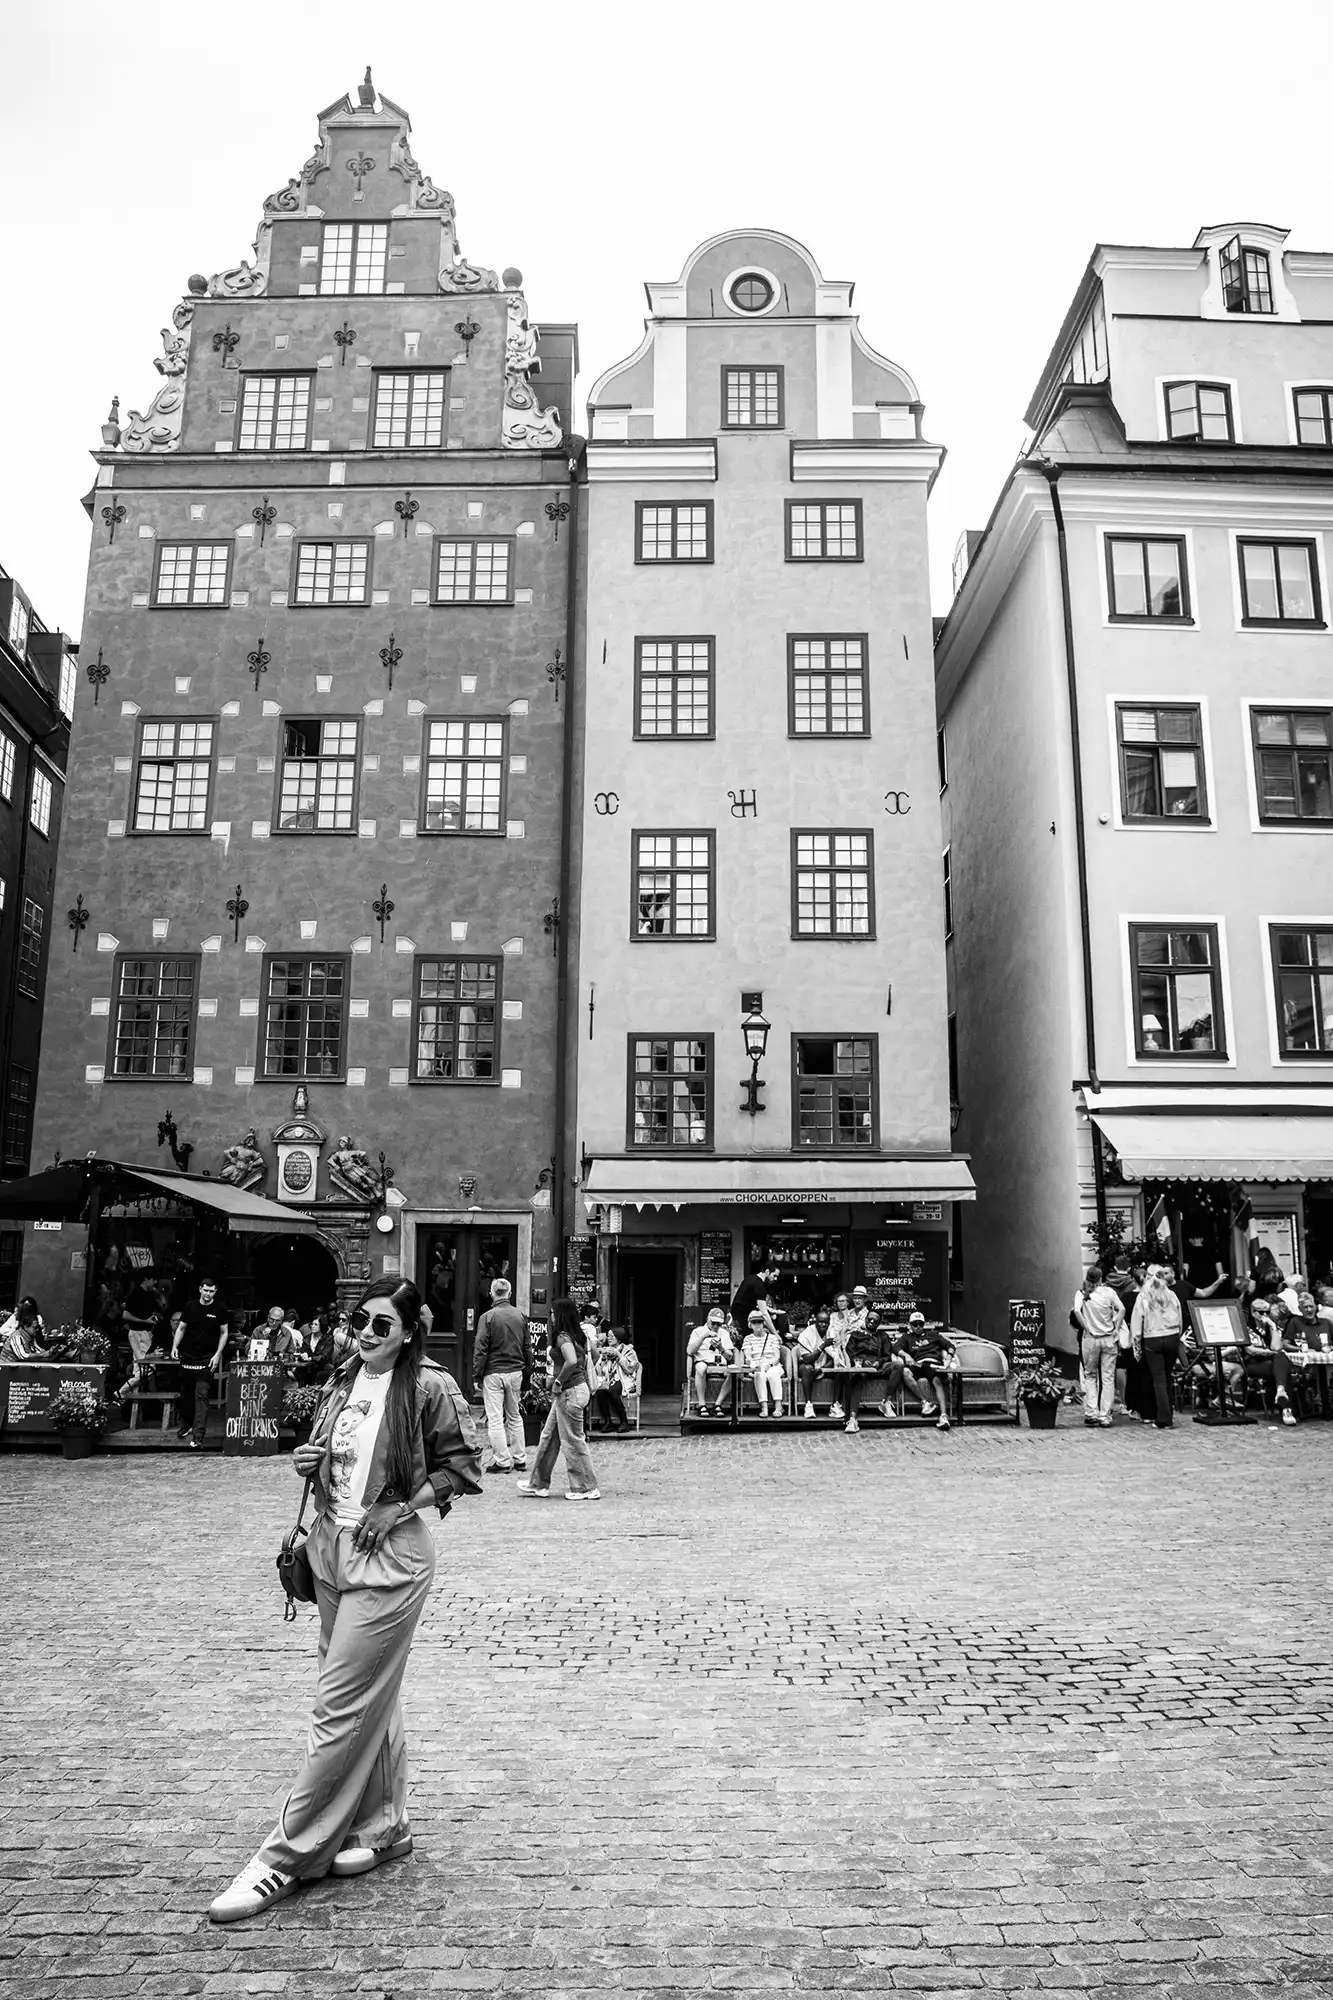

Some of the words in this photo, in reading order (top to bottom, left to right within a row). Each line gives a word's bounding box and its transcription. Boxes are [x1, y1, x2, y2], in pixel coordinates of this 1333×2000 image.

[1012, 1304, 1040, 1318] TAKE
[527, 1321, 548, 1334] REAM
[1013, 1320, 1043, 1337] AWAY
[236, 1365, 249, 1378] WE
[251, 1364, 274, 1377] SERVE
[60, 1380, 92, 1389] WELCOME
[240, 1383, 268, 1400] BEER
[240, 1399, 267, 1418] WINE
[250, 1417, 279, 1439] DRINKS
